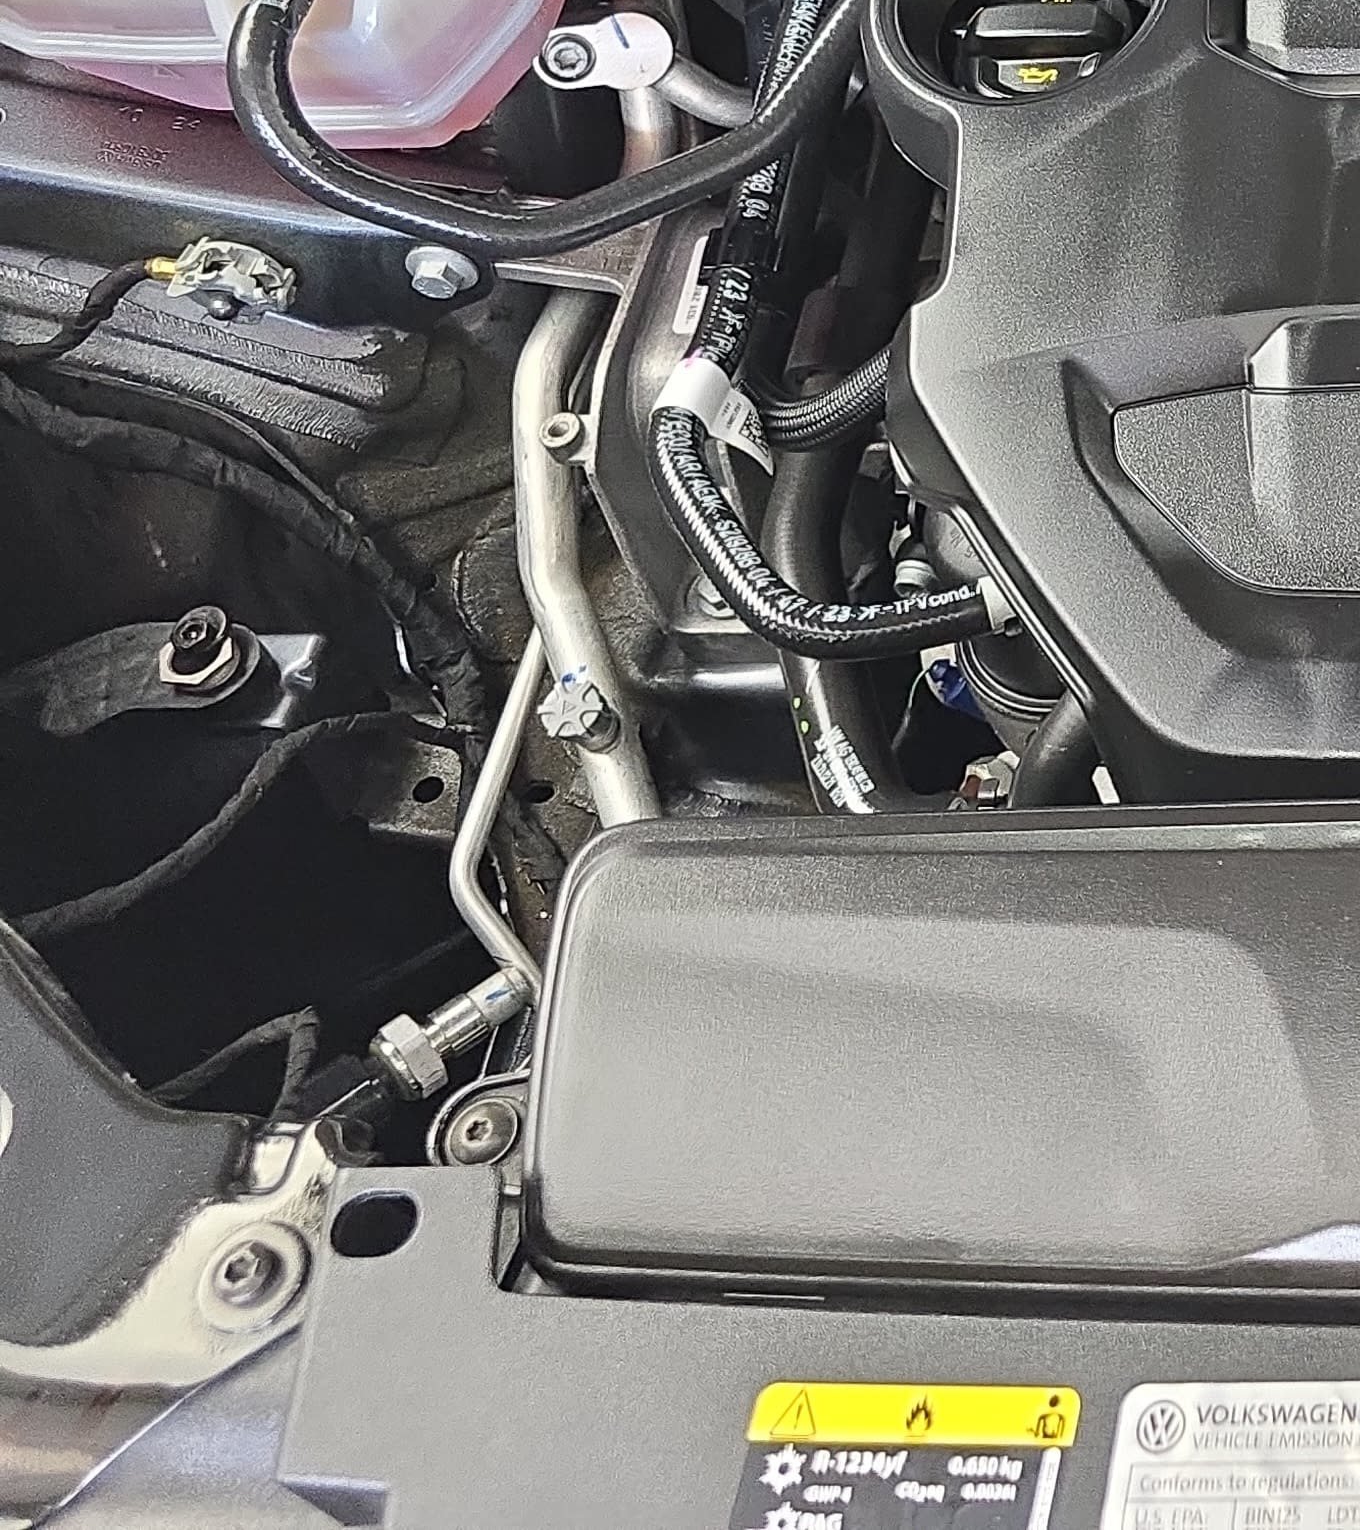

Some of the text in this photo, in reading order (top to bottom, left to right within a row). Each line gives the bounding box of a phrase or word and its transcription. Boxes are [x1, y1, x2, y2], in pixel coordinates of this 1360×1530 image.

[1196, 1402, 1358, 1426] VOLKSWAGEN
[1193, 1431, 1259, 1450] VEHICLE
[1268, 1430, 1353, 1449] EMISSION
[1139, 1474, 1223, 1492] Conforms
[1229, 1475, 1247, 1490] to
